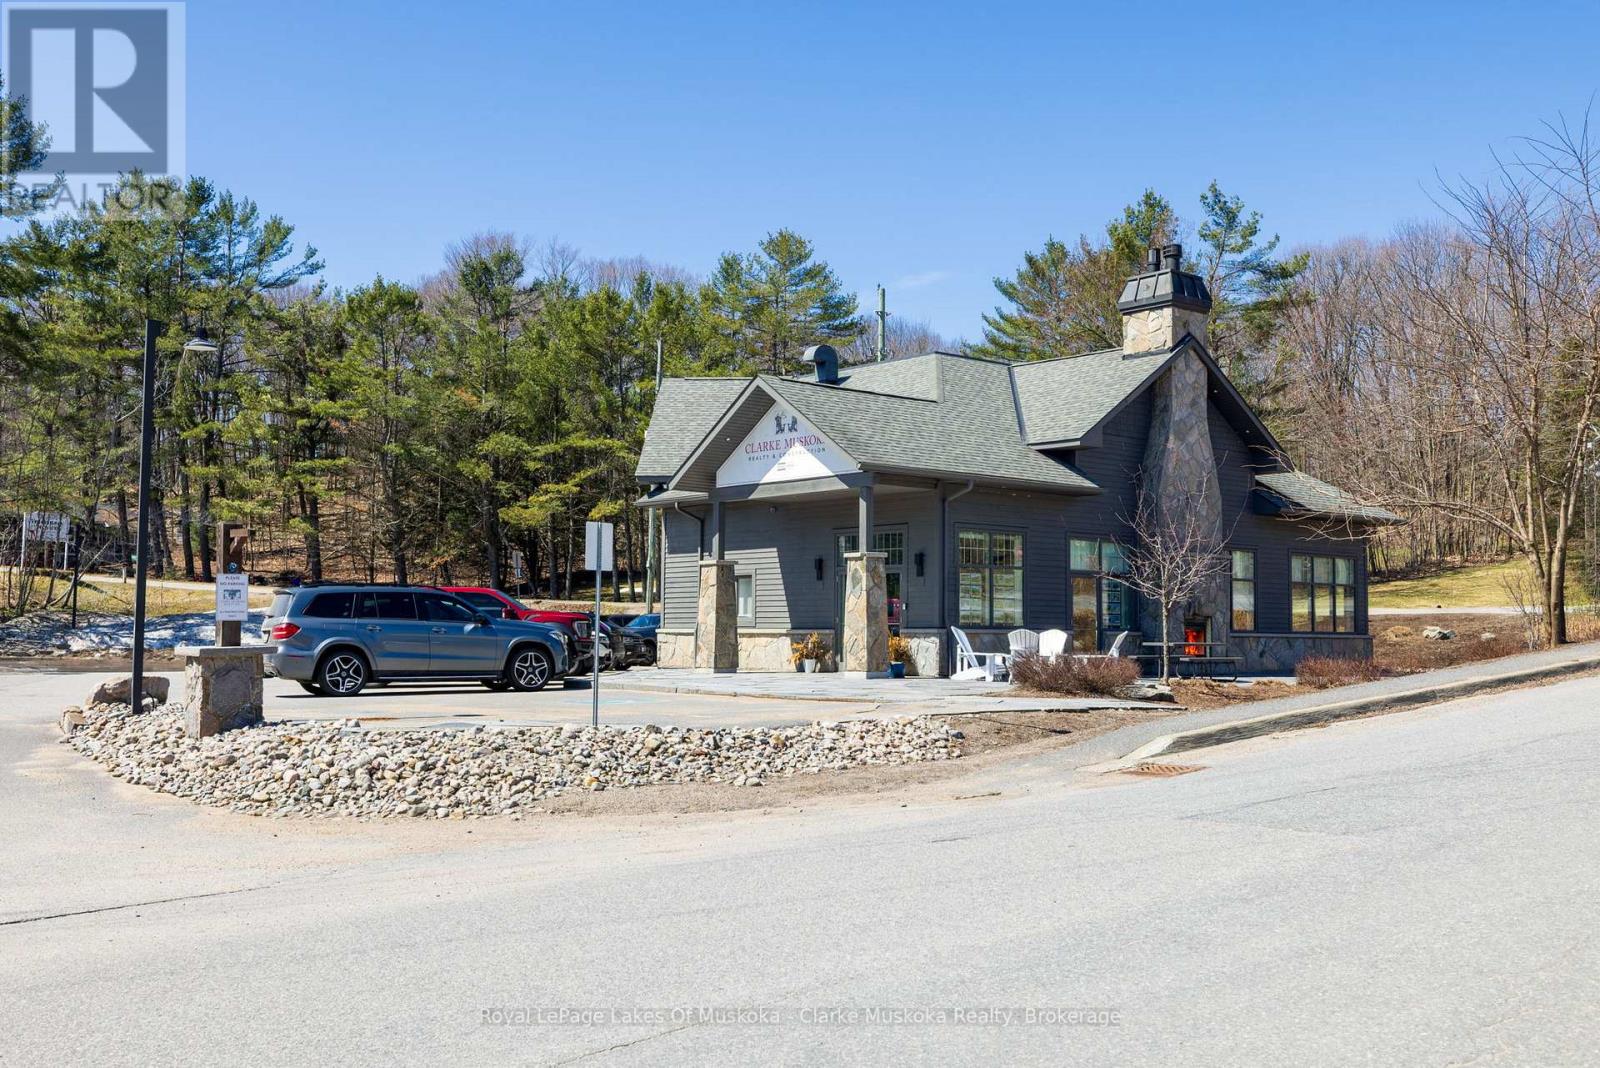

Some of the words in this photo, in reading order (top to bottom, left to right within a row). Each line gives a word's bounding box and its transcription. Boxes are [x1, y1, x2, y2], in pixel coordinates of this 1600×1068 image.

[745, 440, 781, 454] CLARKE
[784, 435, 825, 449] MUSKOK
[748, 453, 770, 461] REALTY
[780, 448, 825, 458] COTION
